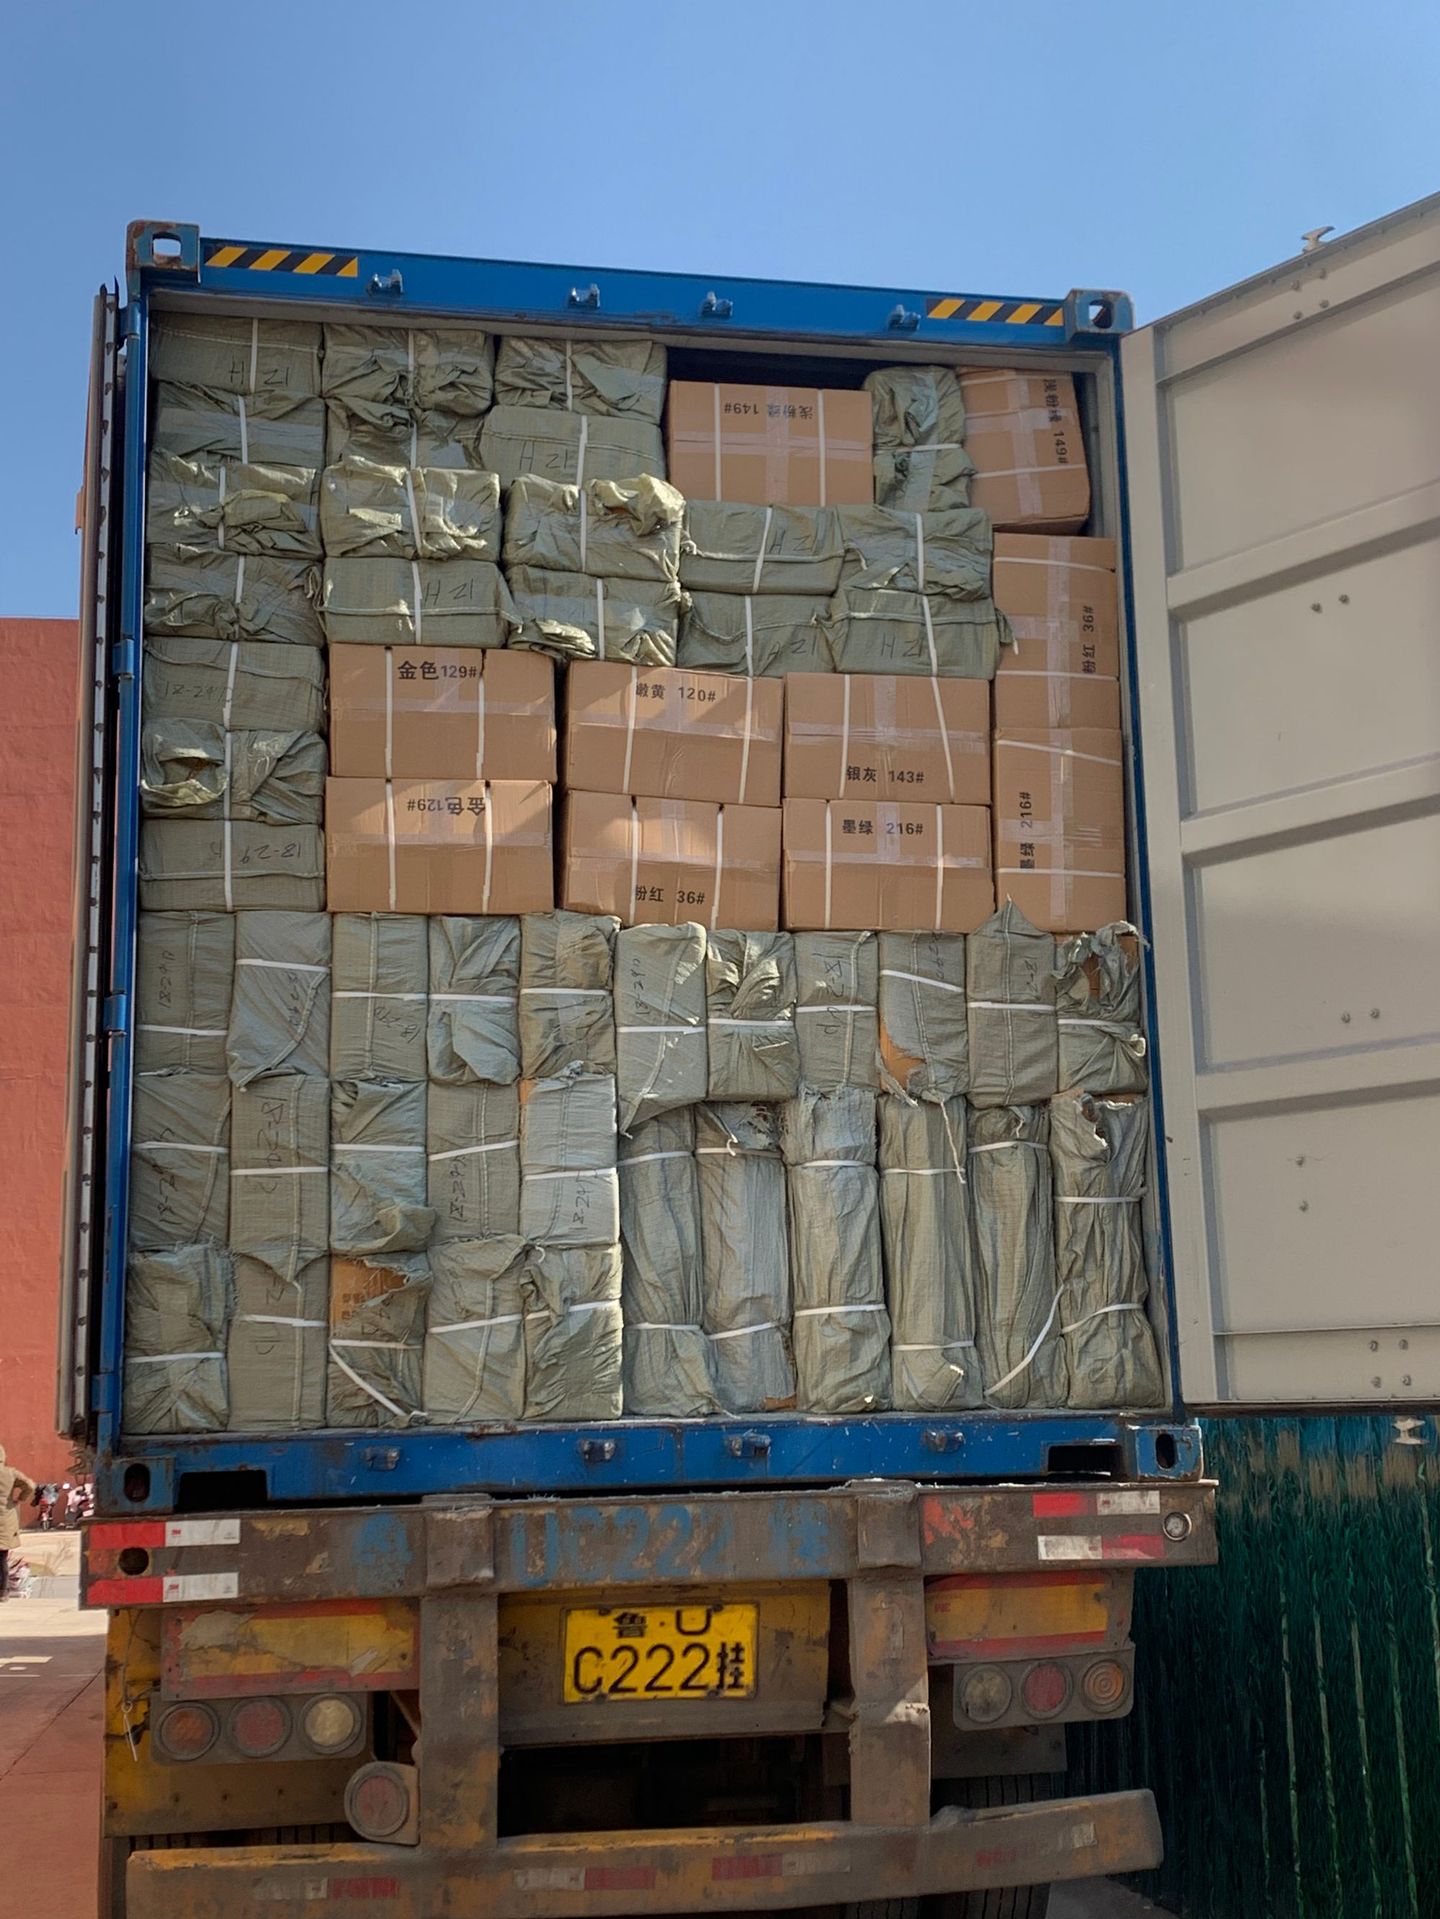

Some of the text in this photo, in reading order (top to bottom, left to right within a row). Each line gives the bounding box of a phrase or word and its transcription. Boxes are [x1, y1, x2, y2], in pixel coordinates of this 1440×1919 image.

[724, 402, 760, 415] 149#
[1053, 430, 1069, 465] 149#
[1082, 605, 1097, 674] 粉红 36#
[679, 685, 716, 702] 120#
[847, 766, 925, 783] 银灰 143#
[1019, 791, 1033, 828] 216#
[842, 819, 924, 835] 墨绿 216#
[635, 885, 705, 904] 粉红 36#
